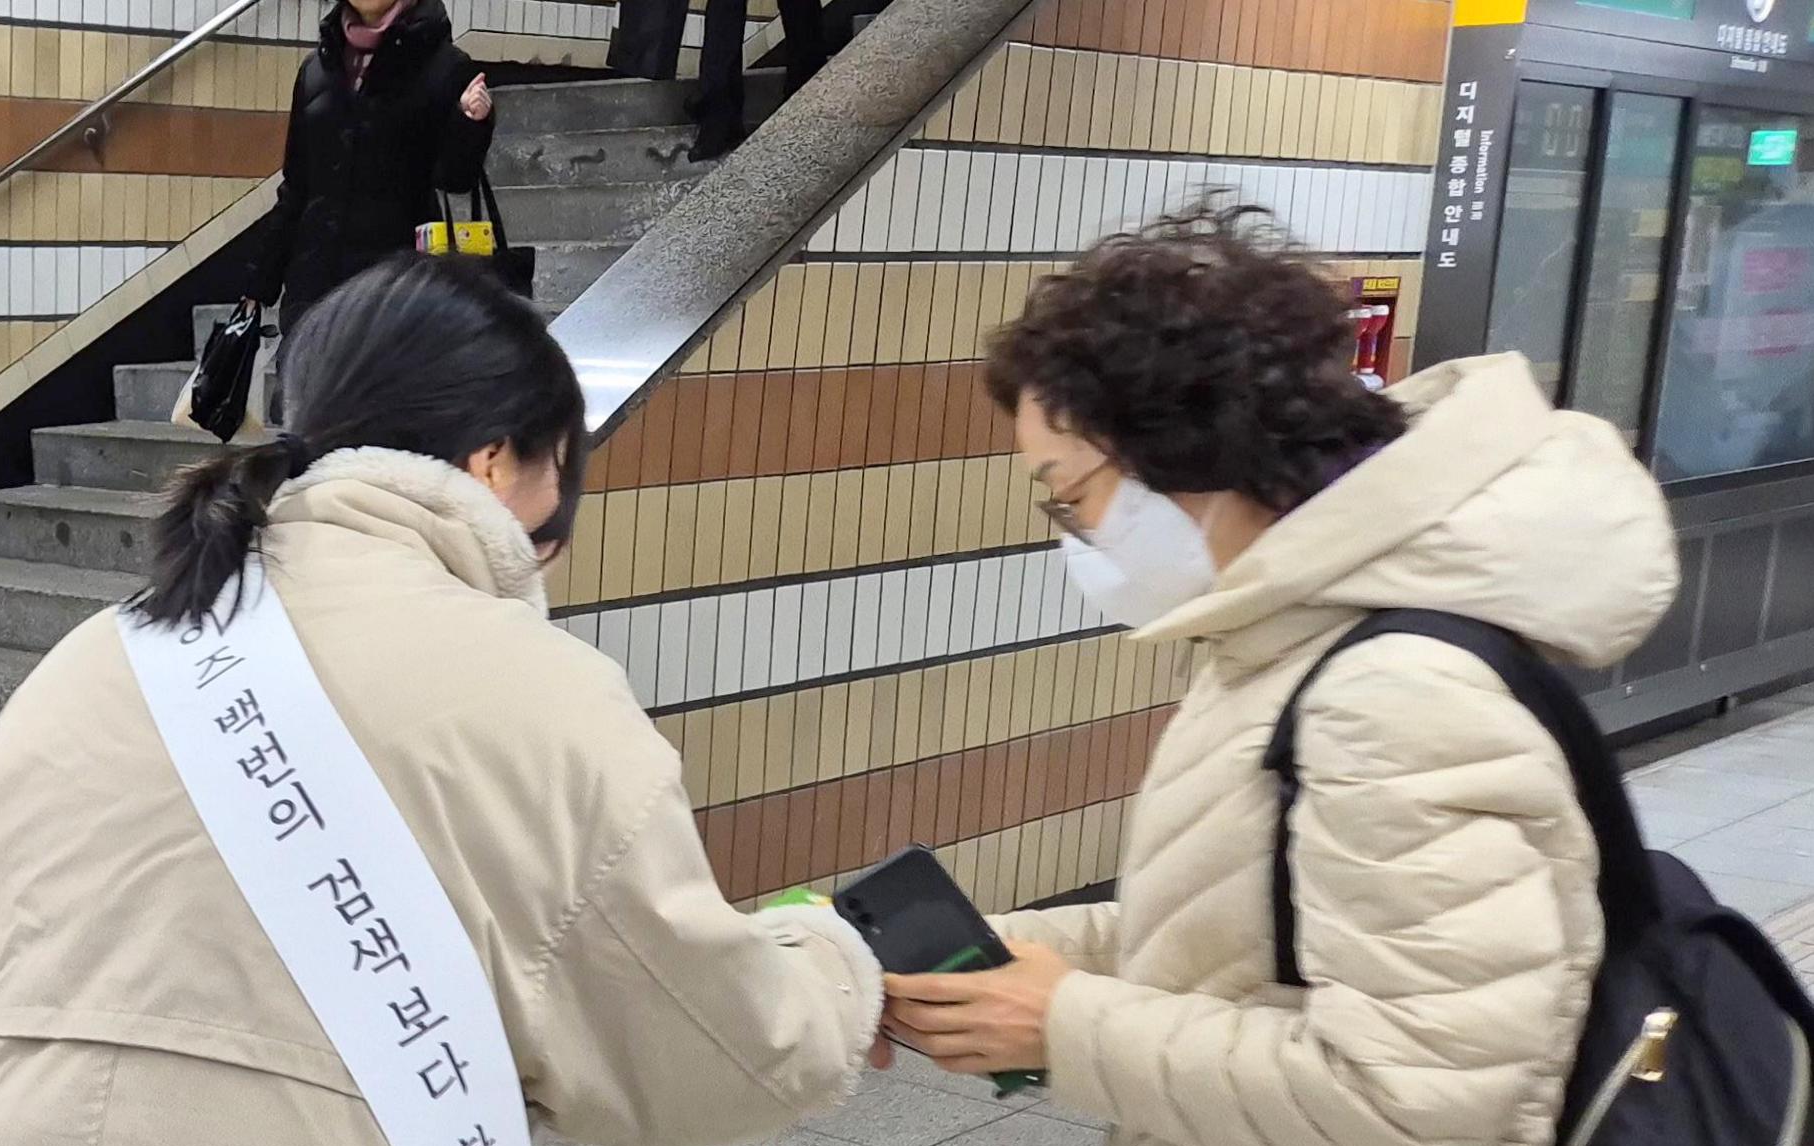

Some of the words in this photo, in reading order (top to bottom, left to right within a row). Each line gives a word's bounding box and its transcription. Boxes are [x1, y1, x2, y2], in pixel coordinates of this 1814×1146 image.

[1474, 130, 1495, 194] Information
[214, 688, 326, 842] 백번의
[307, 857, 472, 1100] 검색보다
